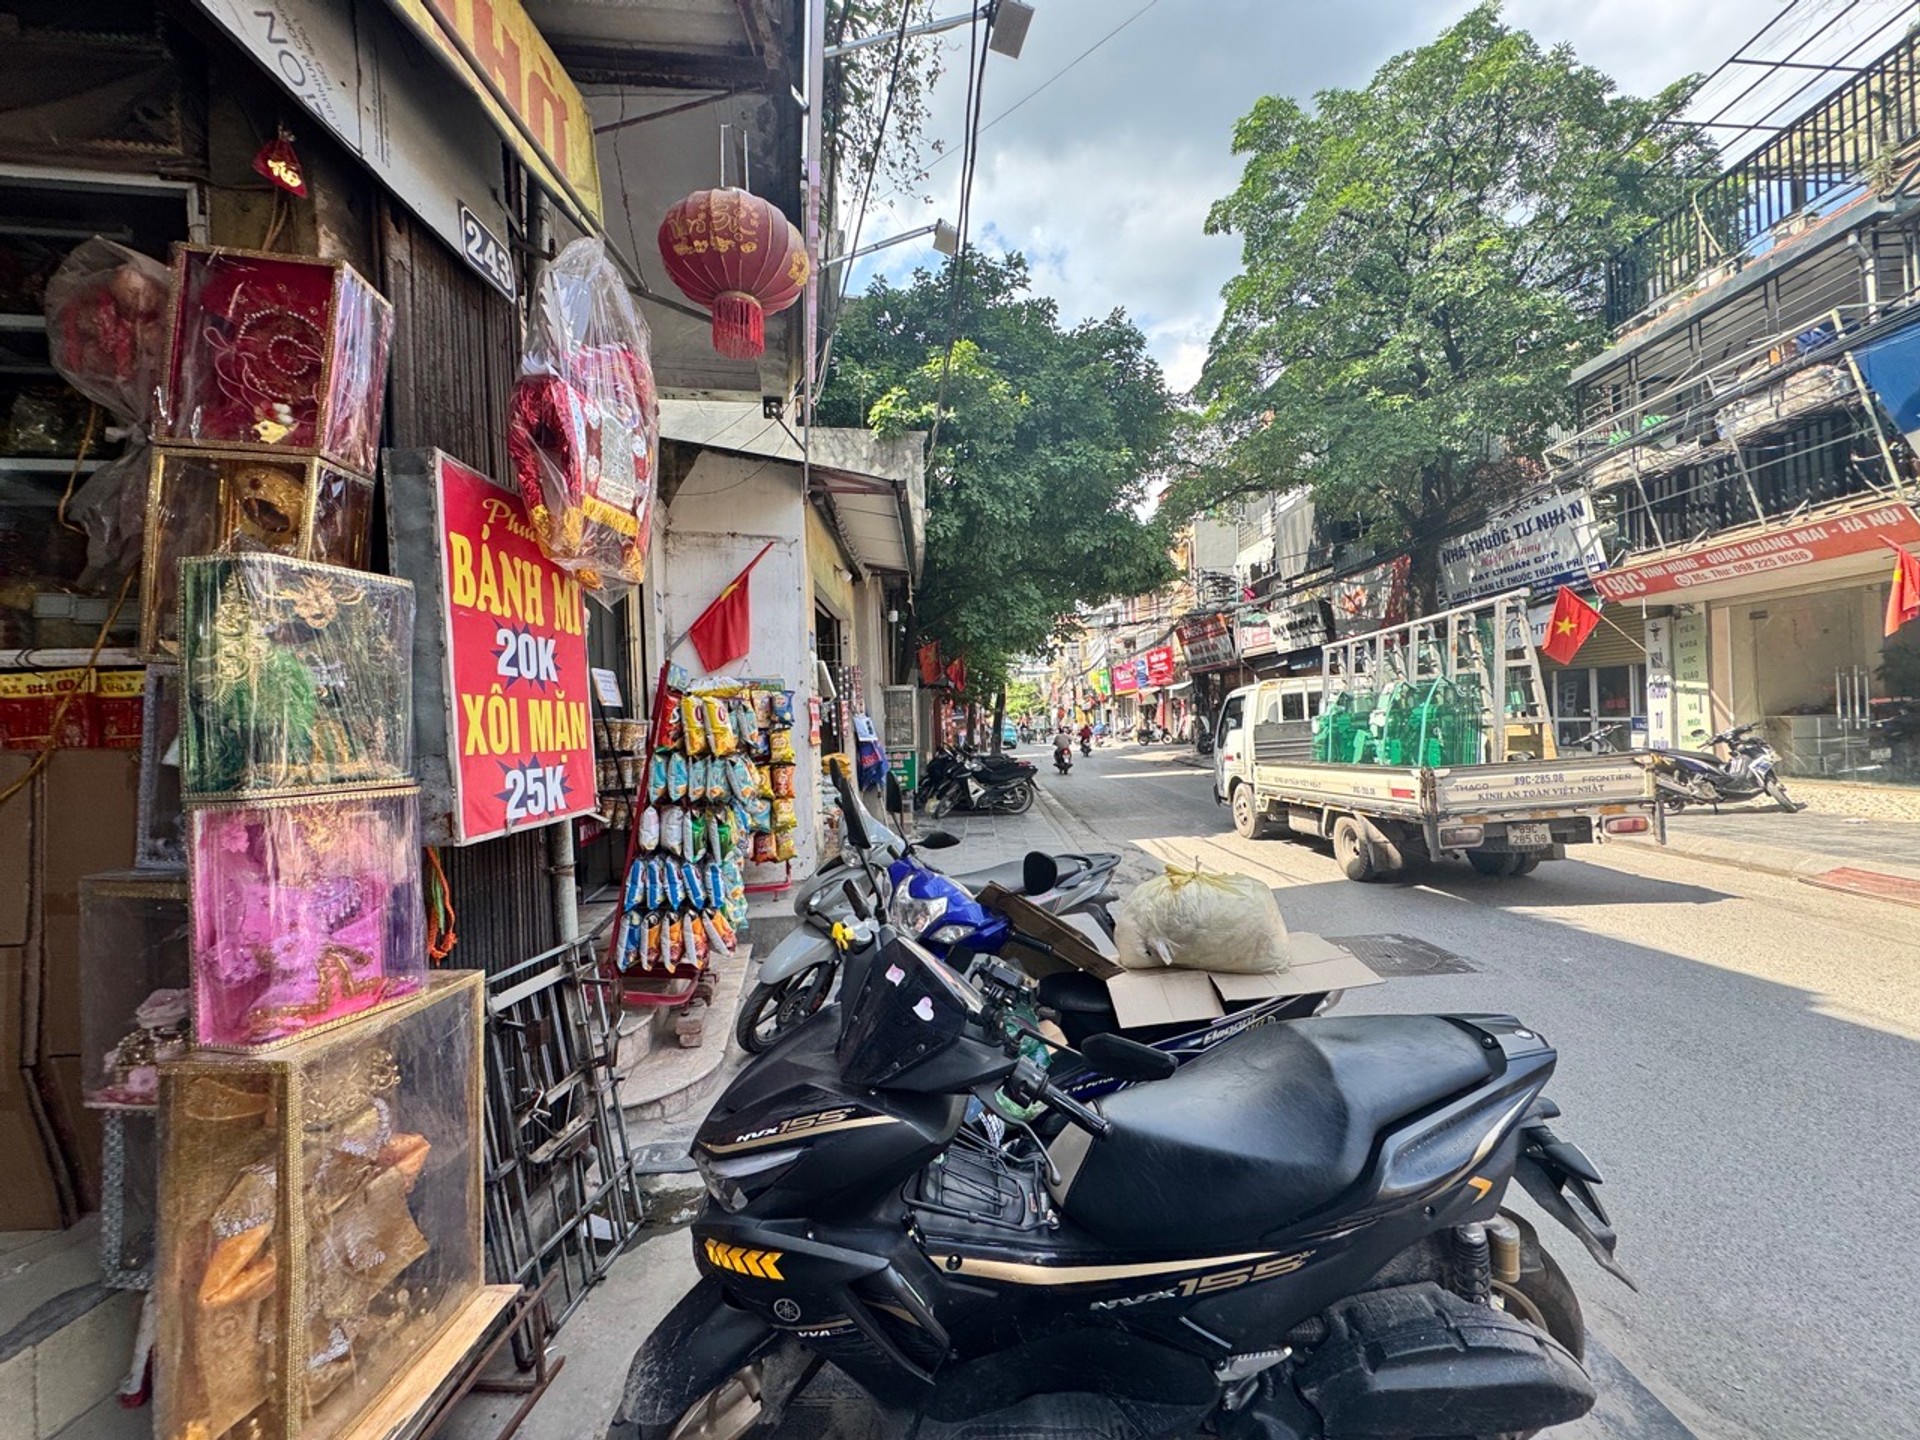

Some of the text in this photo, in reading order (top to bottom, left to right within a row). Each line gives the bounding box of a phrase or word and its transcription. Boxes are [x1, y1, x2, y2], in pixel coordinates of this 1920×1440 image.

[466, 220, 512, 290] 243
[1513, 519, 1533, 540] TƯ
[1706, 547, 1742, 565] QUẬN
[1743, 534, 1795, 556] HOÀNG
[1793, 526, 1829, 545] MAI
[1838, 516, 1866, 534] HÀ
[1866, 508, 1905, 527] NỘI
[1733, 561, 1754, 574] 098
[1754, 556, 1778, 569] 225
[1596, 571, 1647, 598] 198C
[496, 628, 558, 683] 20K
[461, 683, 588, 763] XÔI MẶN
[505, 764, 567, 820] 25K
[1478, 790, 1503, 800] KÍNH
[1507, 790, 1521, 799] AN
[1523, 787, 1550, 798] TOÀN
[1552, 785, 1576, 796] VIỆT
[1519, 824, 1538, 834] 89C
[736, 1110, 850, 1143] NVX 155
[1177, 1254, 1307, 1298] 155
